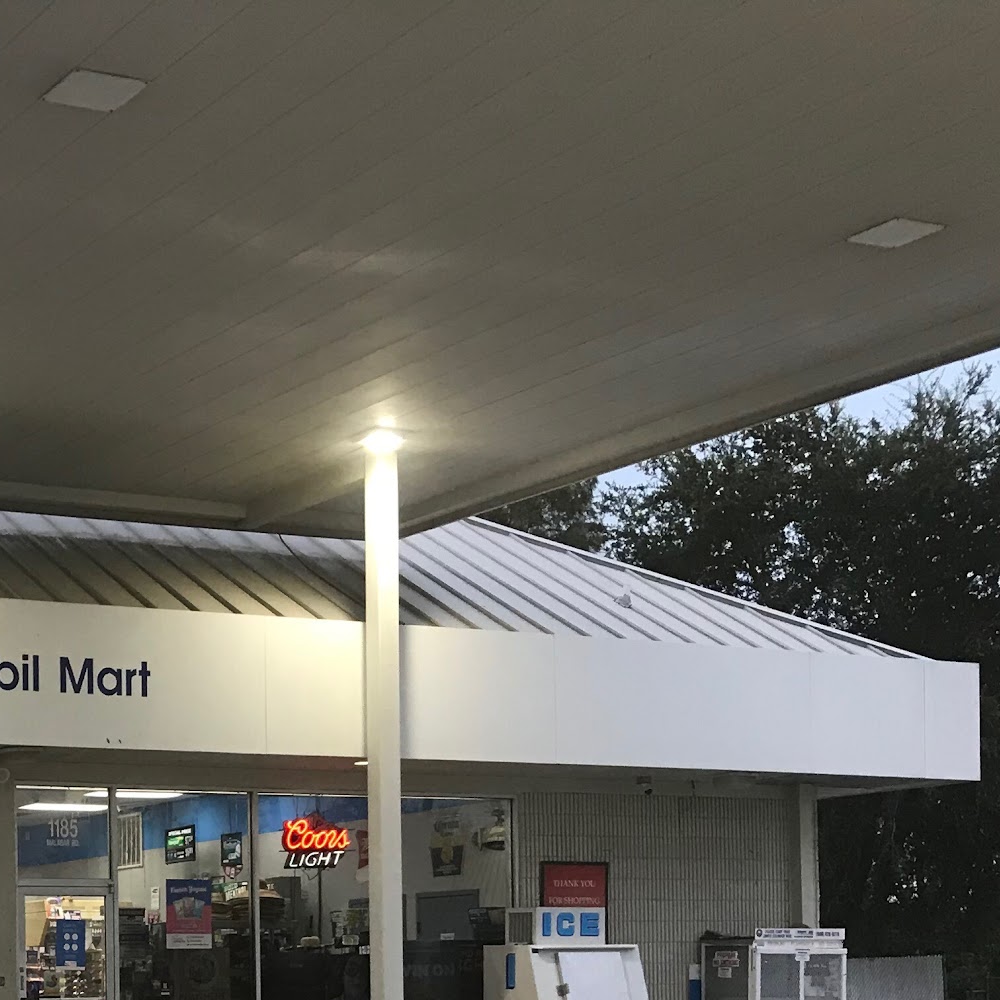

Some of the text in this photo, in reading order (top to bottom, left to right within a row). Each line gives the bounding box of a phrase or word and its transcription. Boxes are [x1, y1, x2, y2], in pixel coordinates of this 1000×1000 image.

[59, 656, 151, 698] Mart
[48, 818, 78, 838] 1185
[286, 819, 351, 850] Coors
[288, 850, 345, 868] LIGHT
[553, 879, 596, 888] THANK YOU
[548, 896, 601, 905] FOR SHOPPING
[542, 912, 600, 937] ICE
